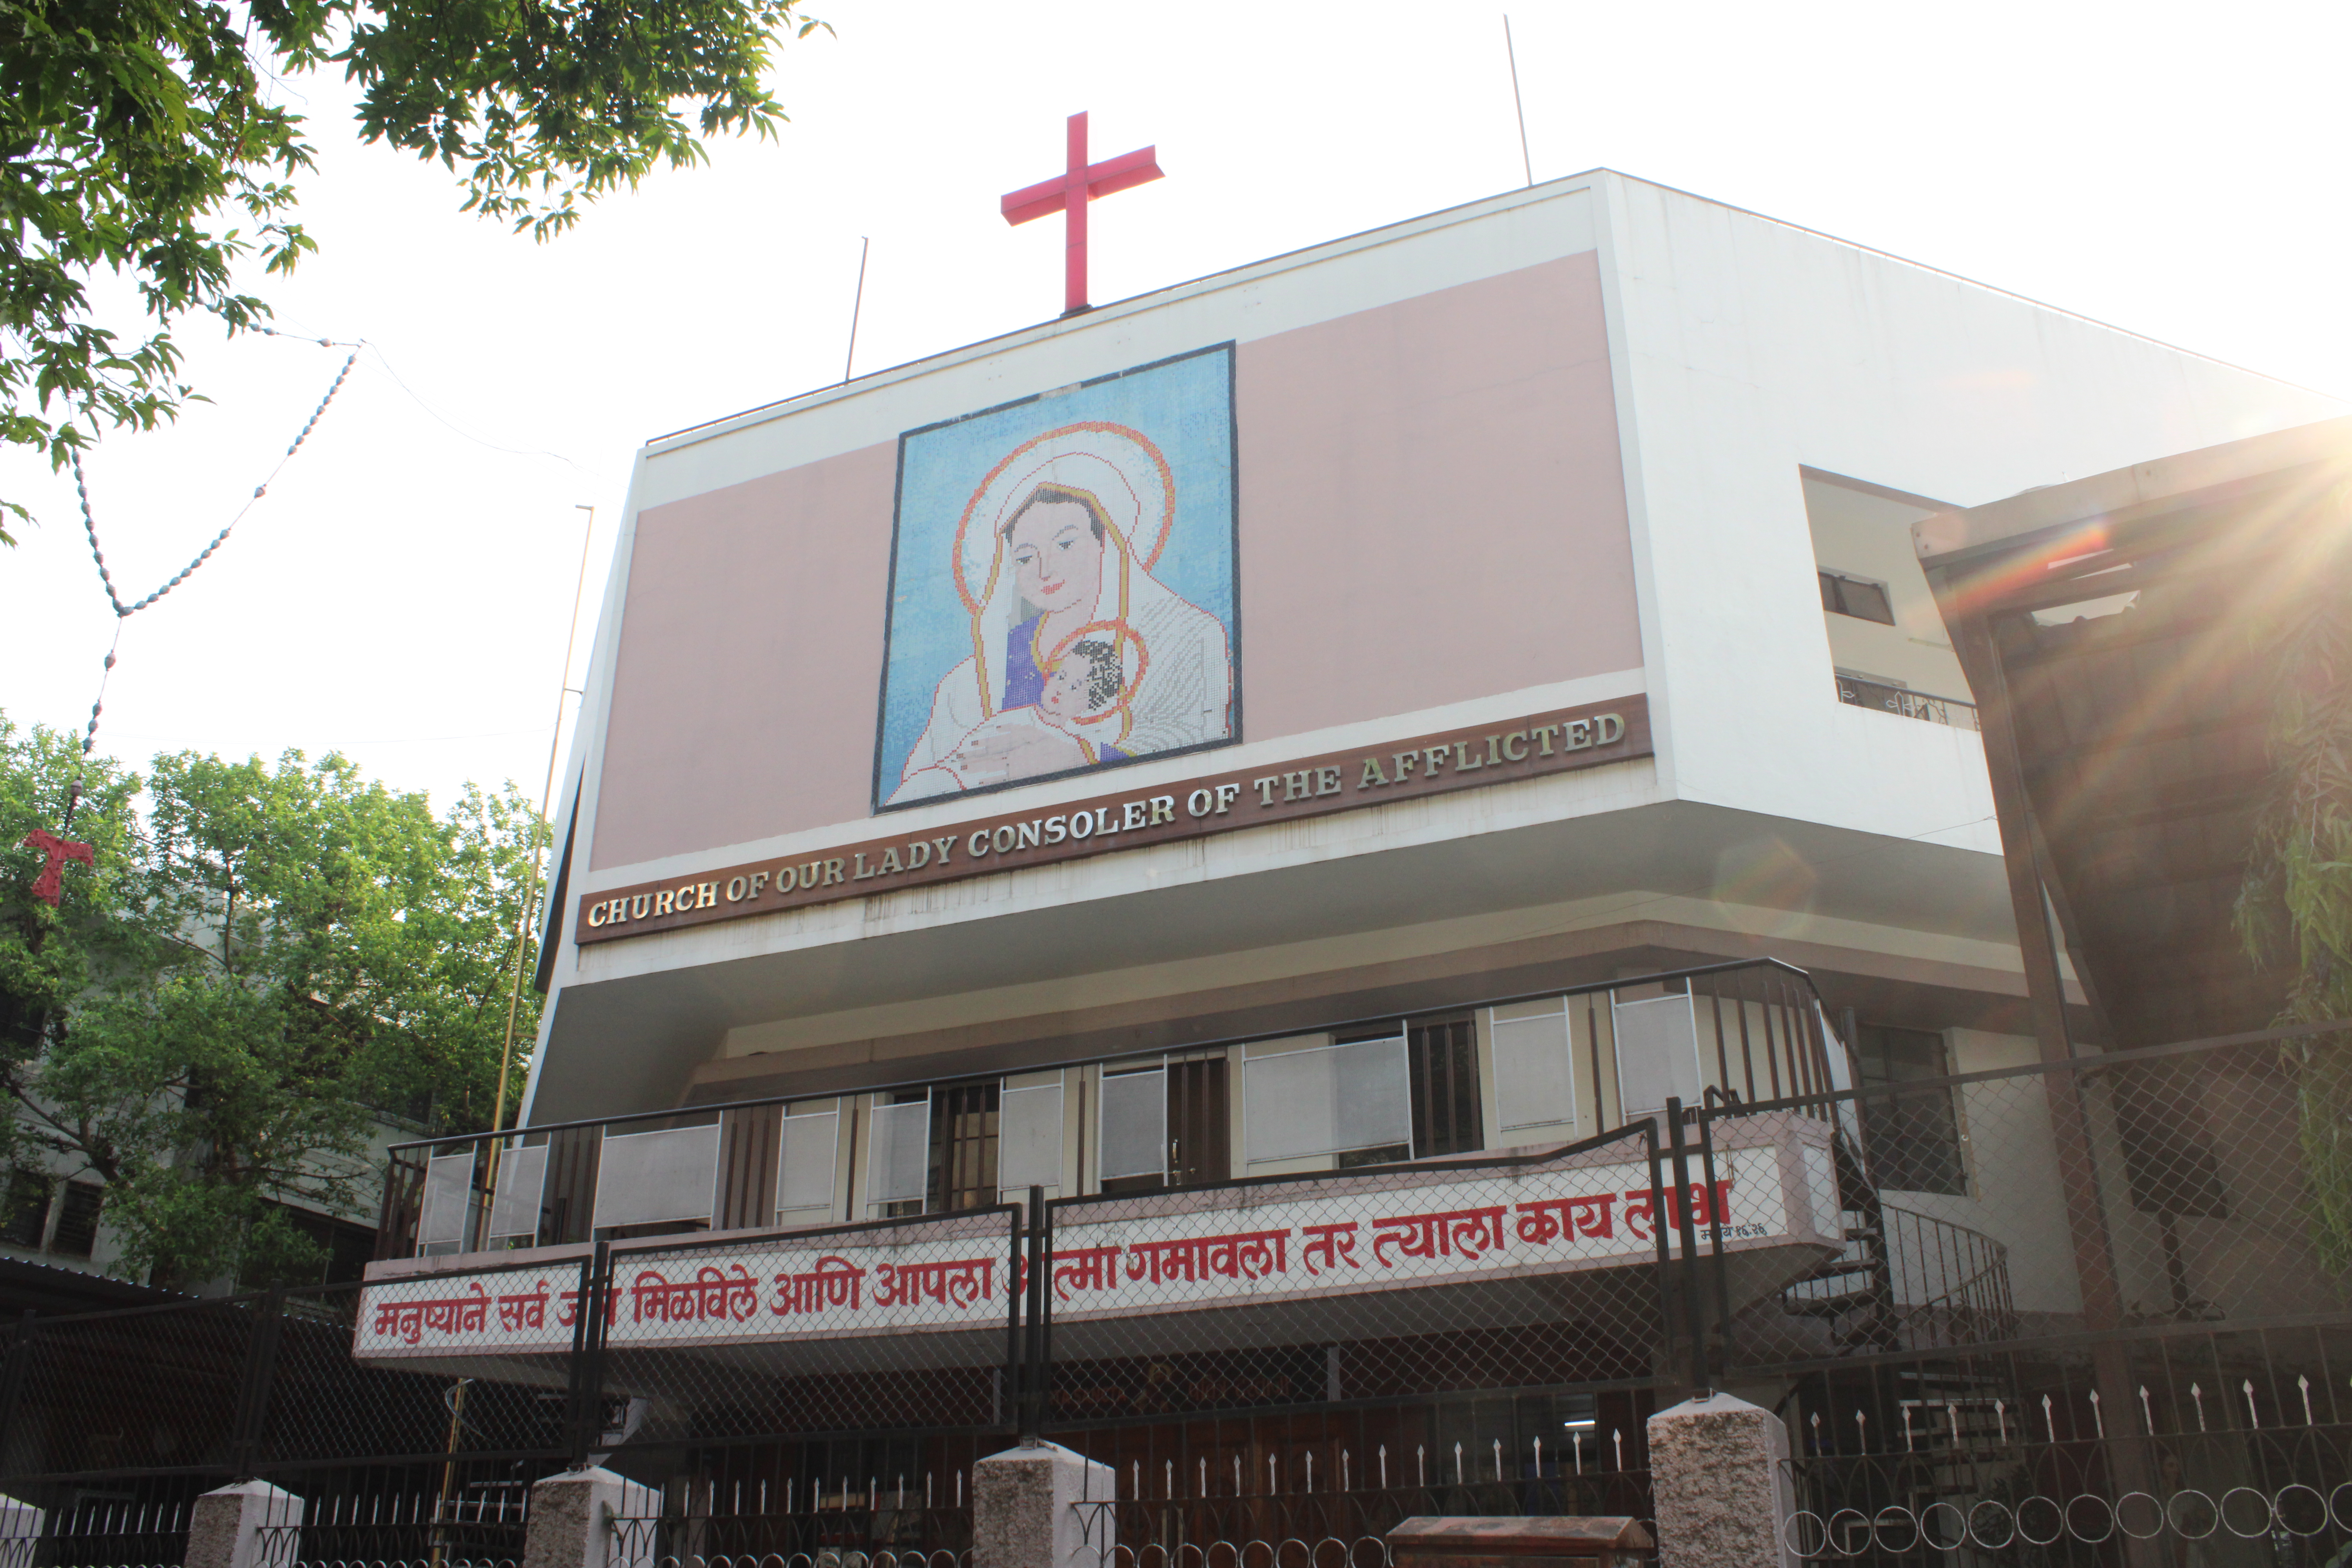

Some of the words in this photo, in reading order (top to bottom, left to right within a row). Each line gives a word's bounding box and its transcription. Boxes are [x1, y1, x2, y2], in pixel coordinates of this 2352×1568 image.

[588, 880, 720, 927] CHURCH
[726, 871, 769, 902] OF
[775, 857, 846, 893] OUR
[853, 835, 958, 880] LADY
[967, 795, 1175, 858] CONSOLER
[1187, 783, 1240, 817] OF
[1254, 765, 1342, 806] THE
[1357, 713, 1625, 789] AFFLICTED
[375, 1282, 492, 1344] मनुष्याने
[499, 1279, 549, 1333] सर्व
[631, 1264, 758, 1323] मिळविले
[769, 1256, 866, 1316] आणि
[872, 1257, 996, 1309] आपला
[1126, 1228, 1291, 1285] गमावला
[1302, 1221, 1360, 1276] तर
[1372, 1205, 1507, 1268] त्याला
[1515, 1193, 1617, 1246] काय
